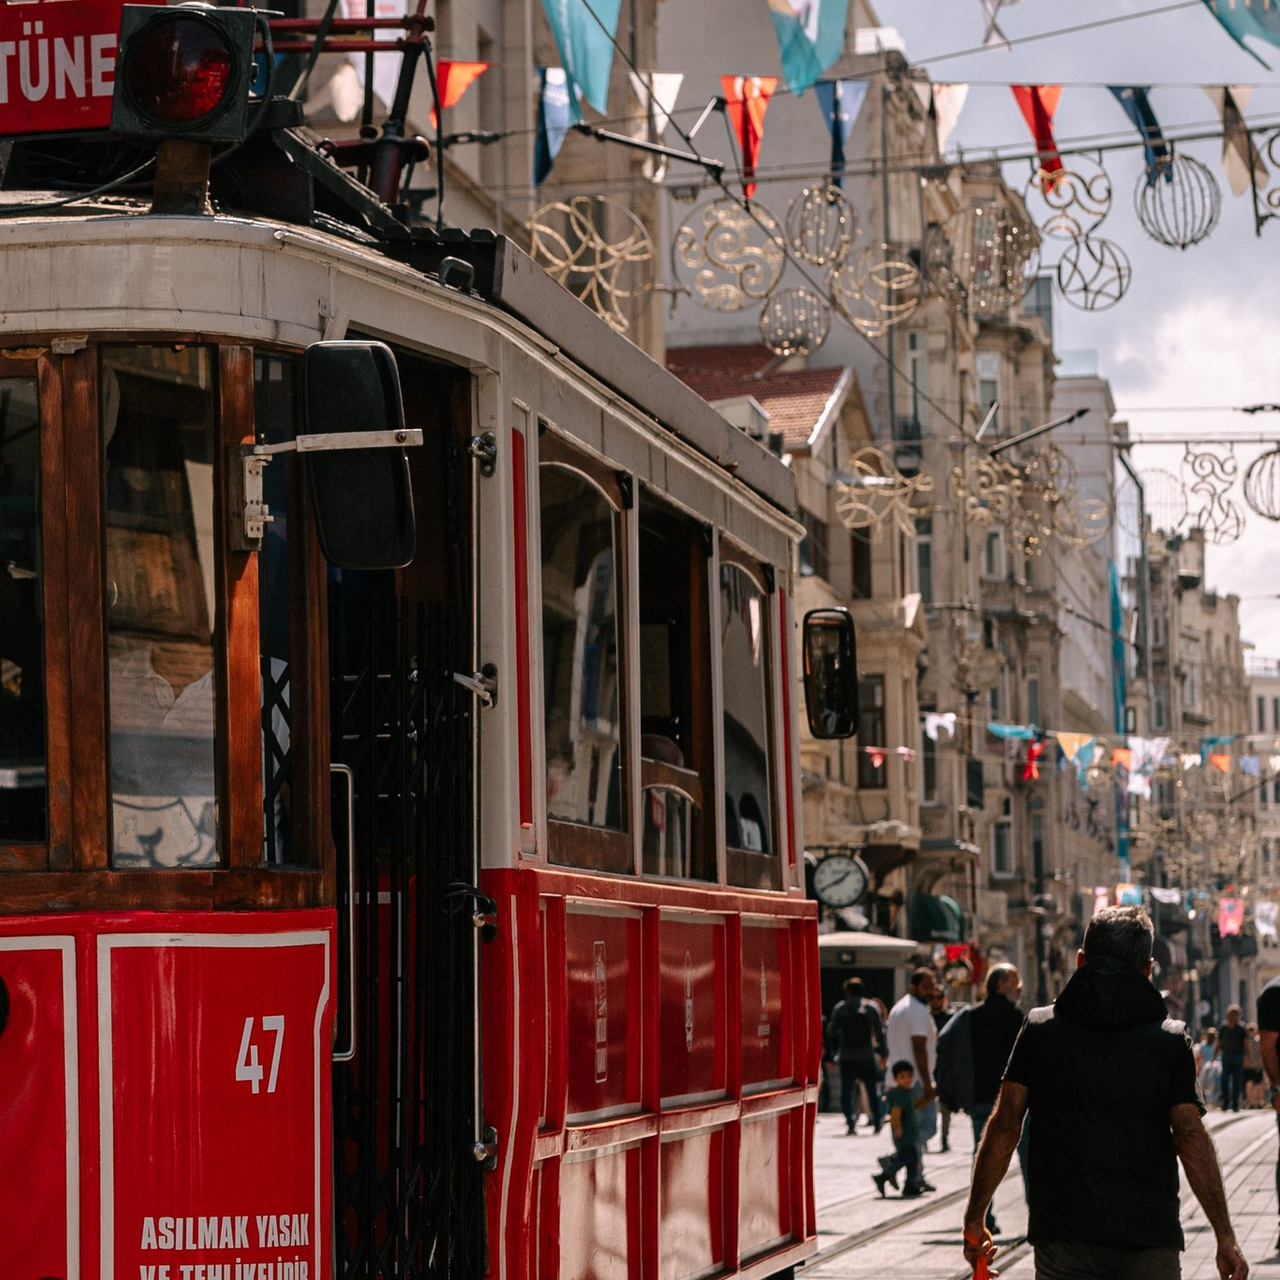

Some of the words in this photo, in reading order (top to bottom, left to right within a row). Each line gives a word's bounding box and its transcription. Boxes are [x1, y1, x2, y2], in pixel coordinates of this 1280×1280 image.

[235, 1014, 285, 1094] 47
[140, 1215, 250, 1251] ASILMAK
[256, 1213, 309, 1248] YASAK
